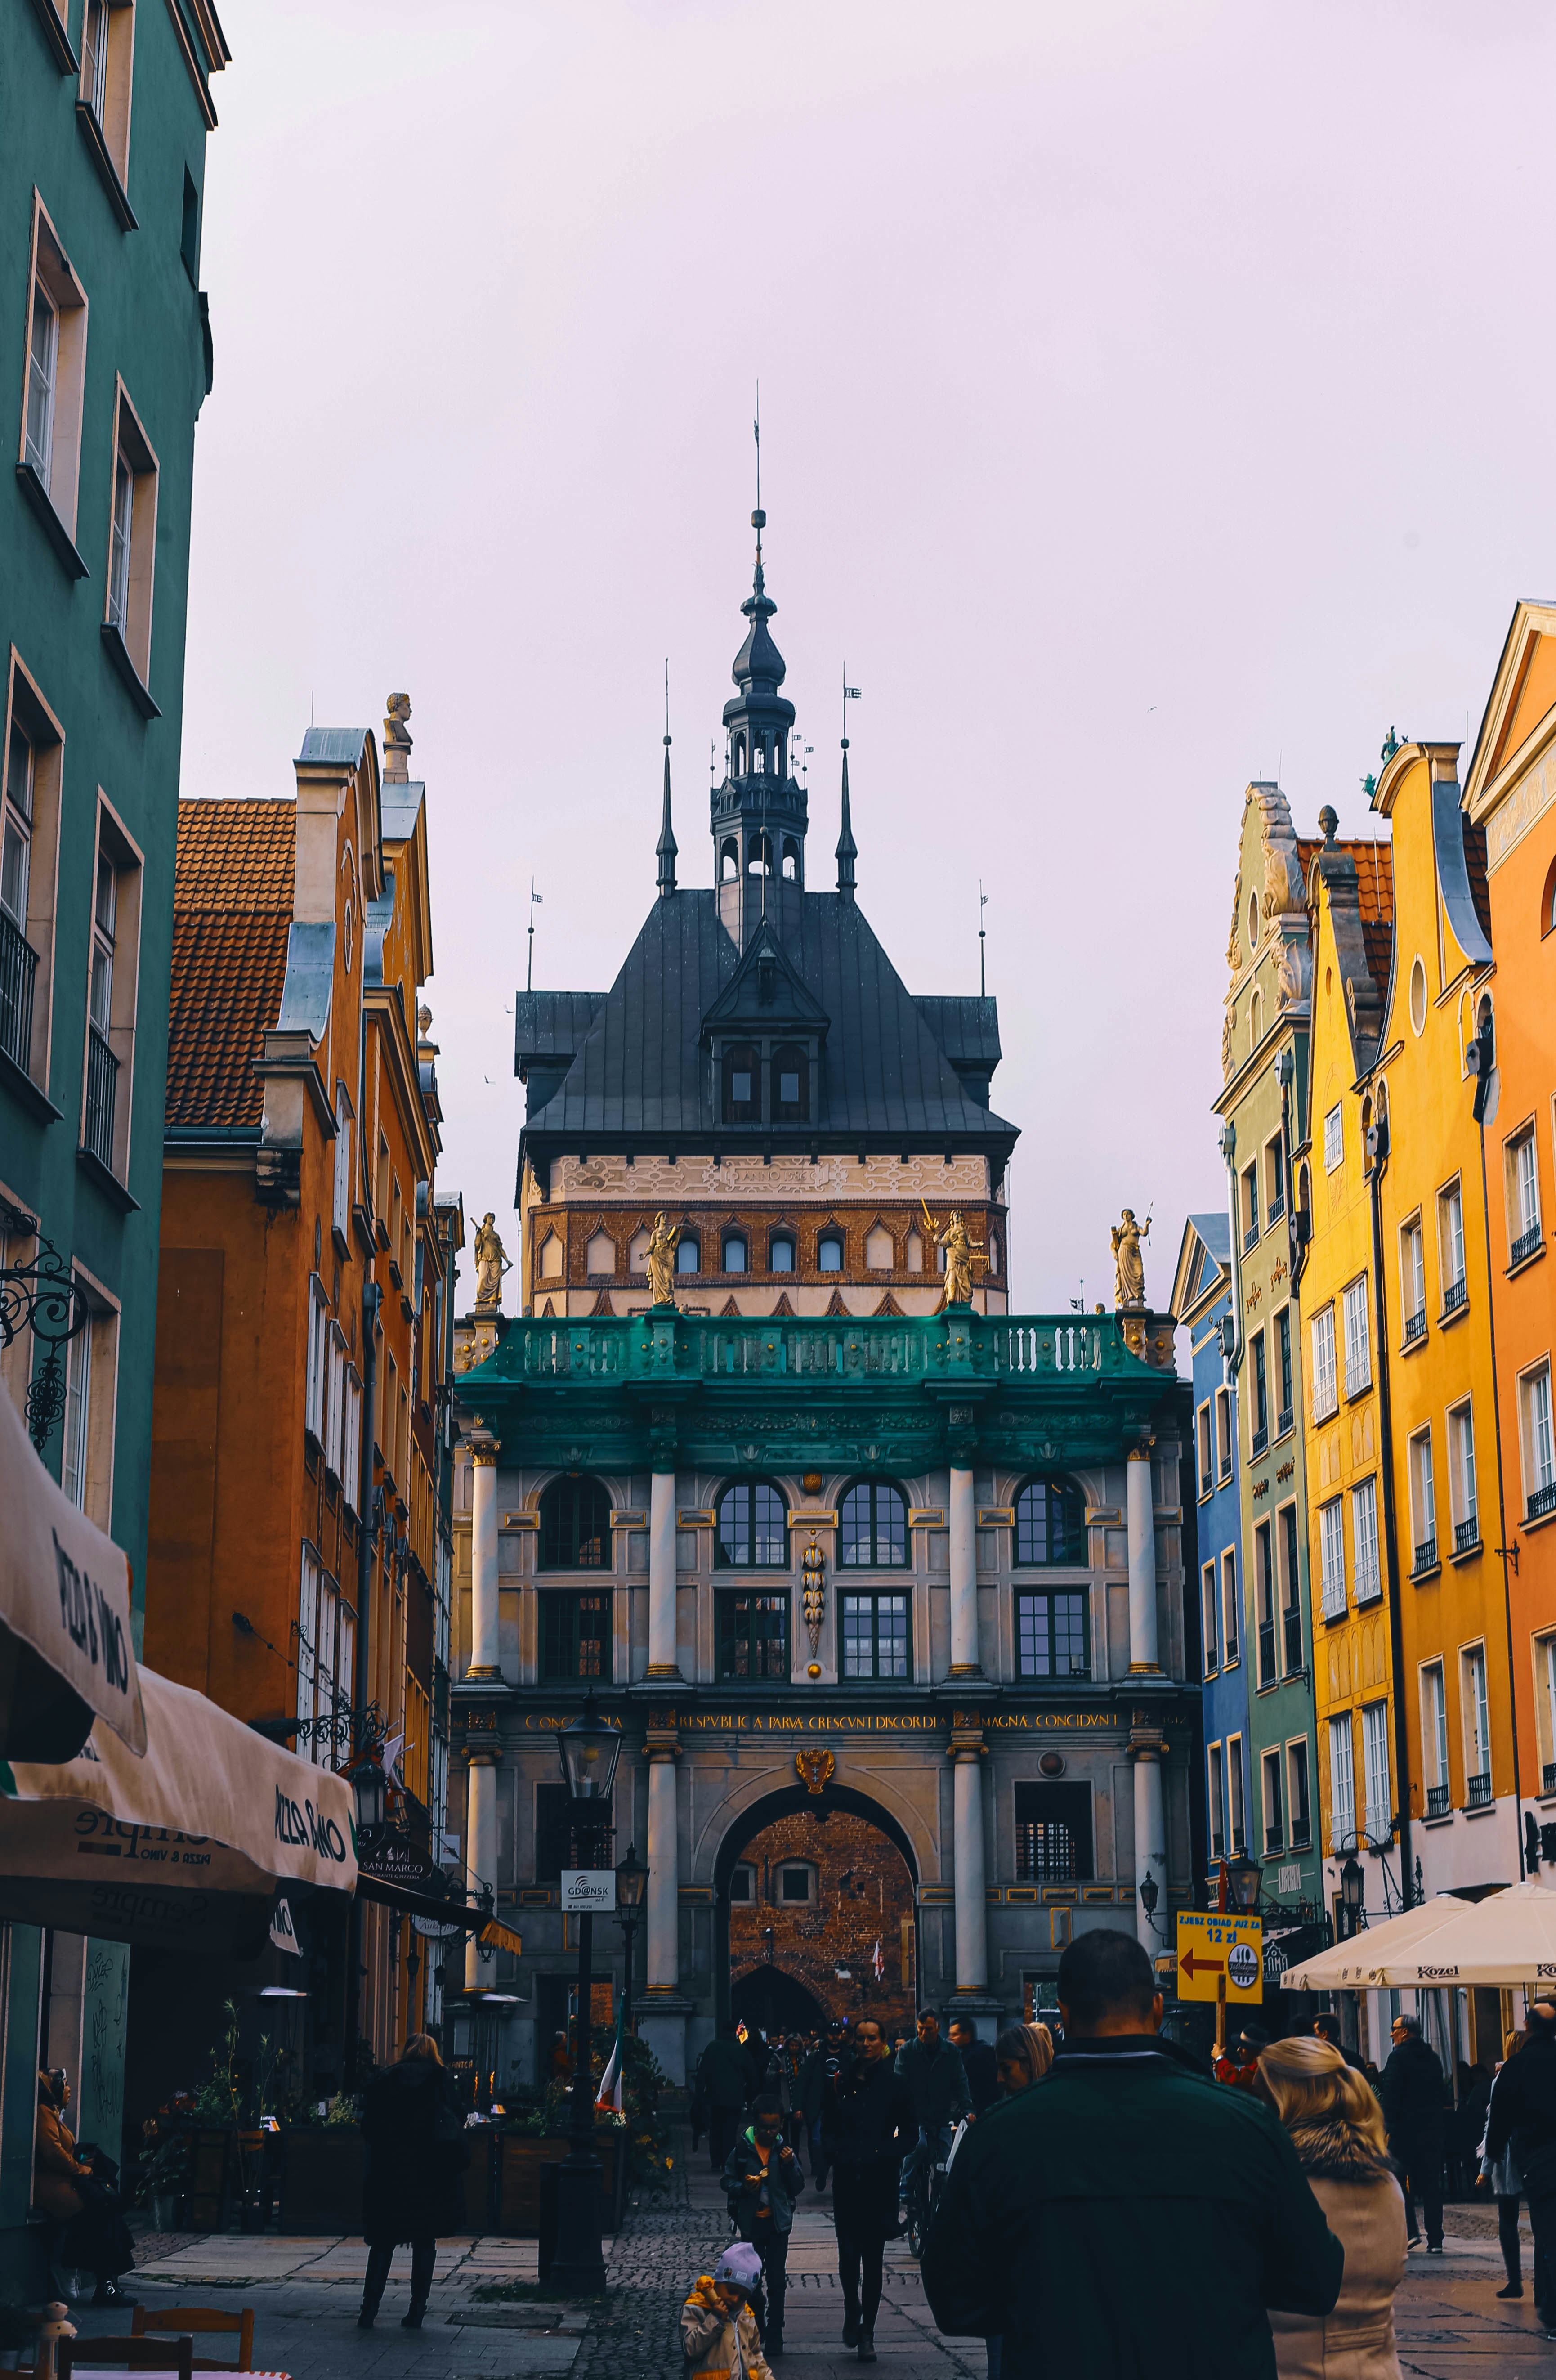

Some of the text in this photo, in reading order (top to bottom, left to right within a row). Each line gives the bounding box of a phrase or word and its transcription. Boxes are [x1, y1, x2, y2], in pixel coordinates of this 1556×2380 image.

[743, 1171, 779, 1181] ANNO
[809, 1716, 874, 1729] CRESCVNT
[1035, 1713, 1118, 1727] CONCIDVNT
[363, 1861, 423, 1873] SAN MARCO
[568, 1886, 608, 1896] GD@ŃSK
[1180, 1916, 1204, 1925] ZJESZ
[1207, 1918, 1231, 1927] OBIAD
[1207, 1928, 1222, 1943] 12
[1417, 1965, 1459, 1978] Kozel
